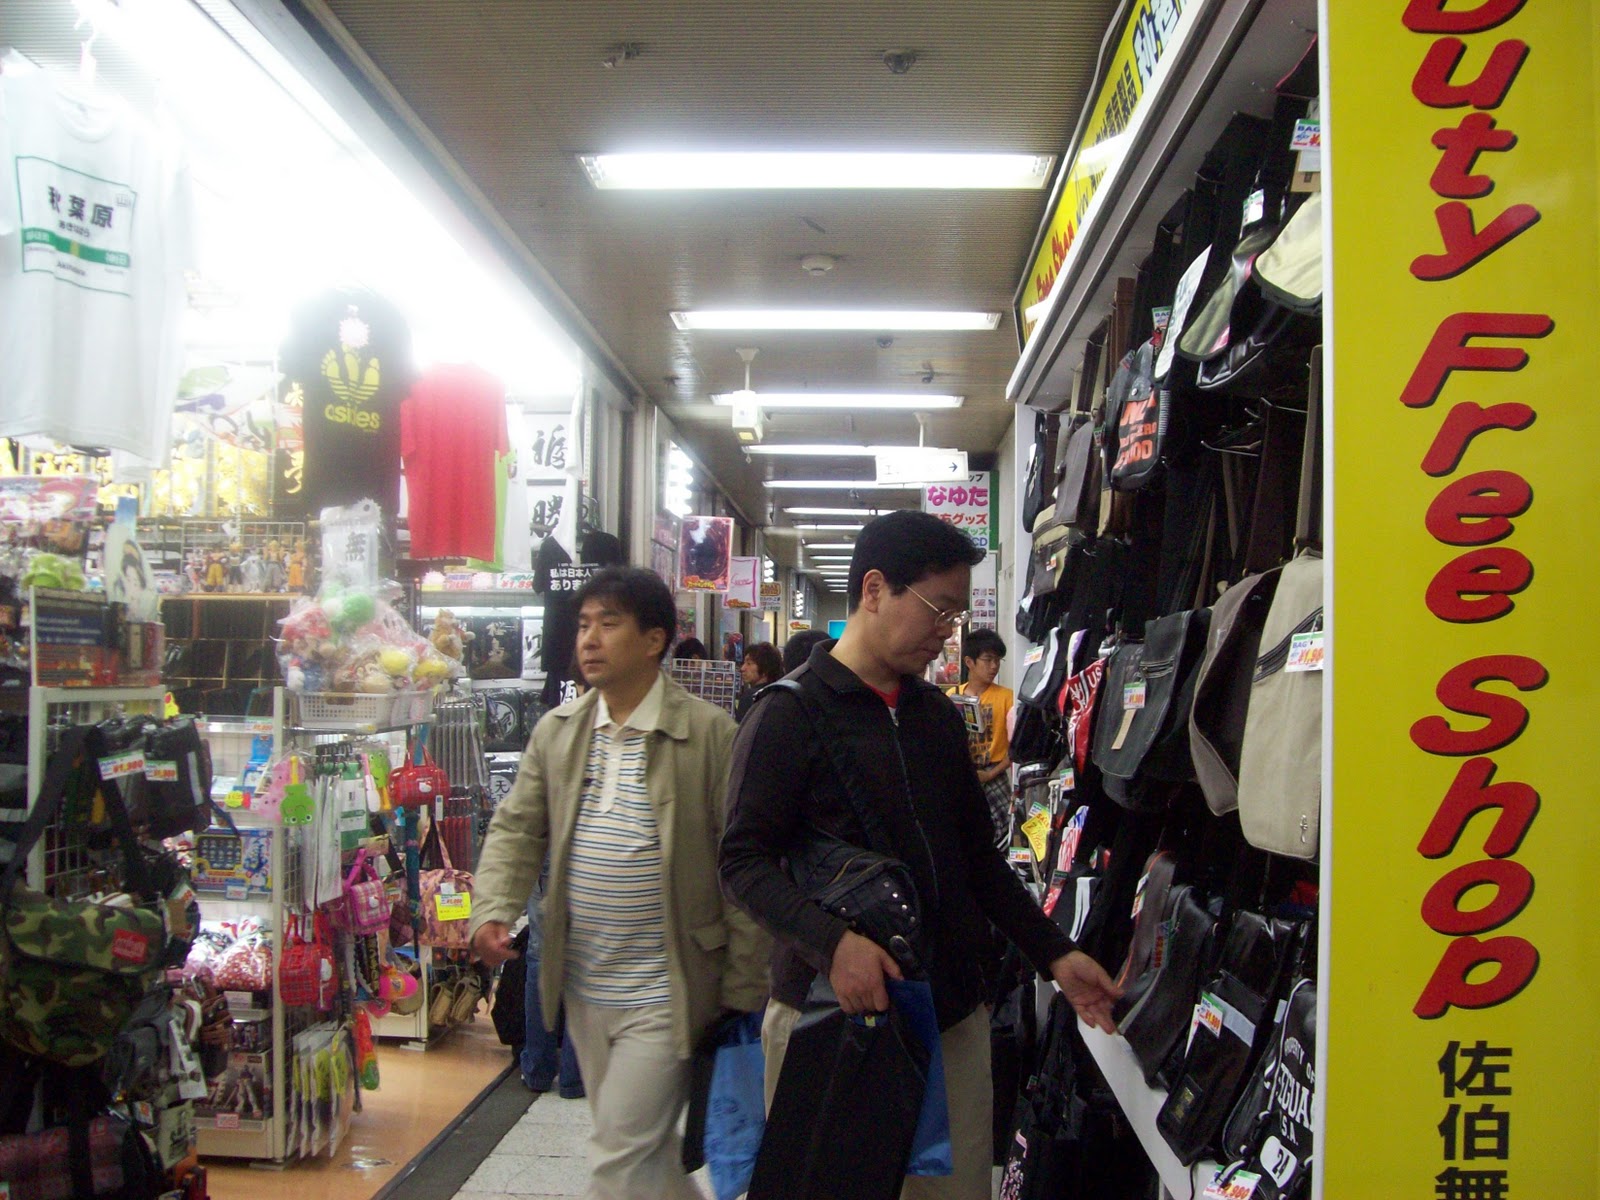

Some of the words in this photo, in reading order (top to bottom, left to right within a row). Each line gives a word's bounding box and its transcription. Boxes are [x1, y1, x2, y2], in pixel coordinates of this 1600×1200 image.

[47, 185, 114, 229] 秋葉原
[967, 472, 985, 483] ップ
[1400, 312, 1556, 624] Free
[927, 485, 989, 507] なゆた
[550, 579, 597, 591] ありま
[1409, 654, 1550, 1020] Shop
